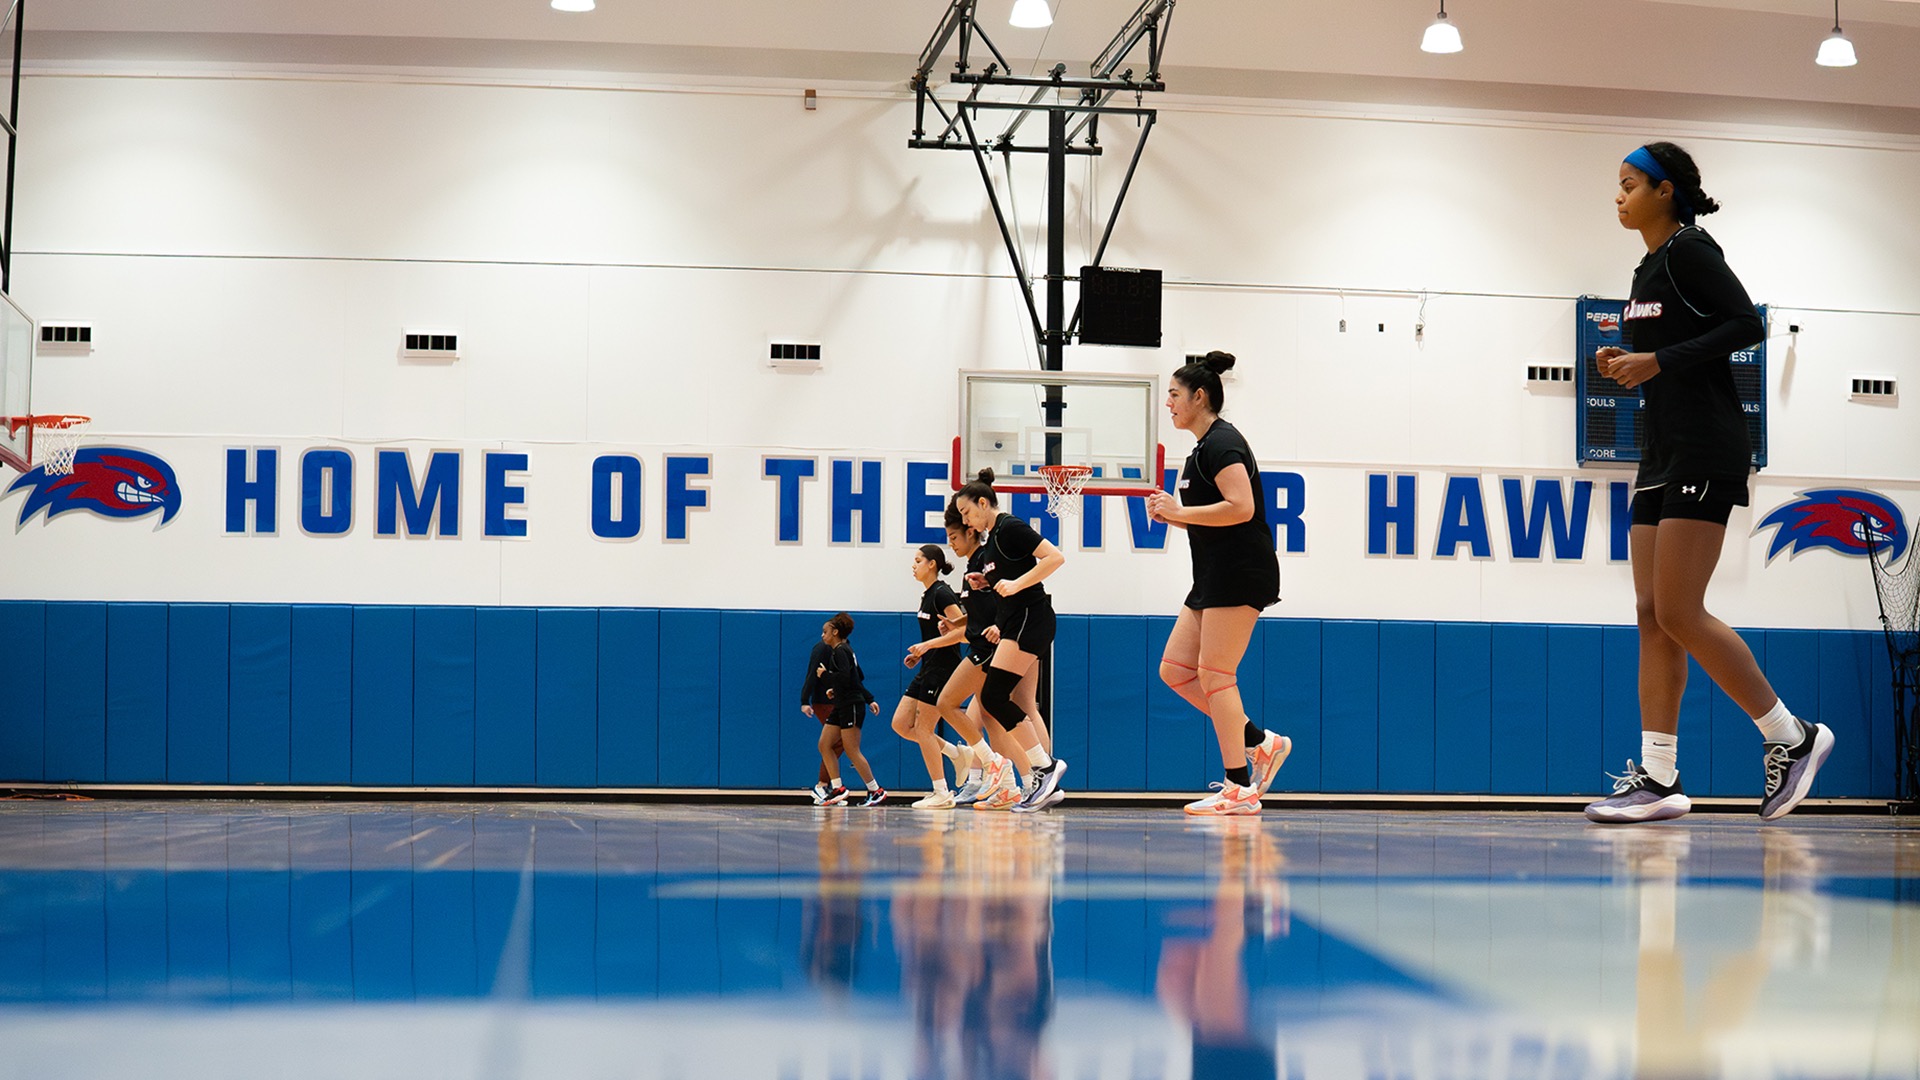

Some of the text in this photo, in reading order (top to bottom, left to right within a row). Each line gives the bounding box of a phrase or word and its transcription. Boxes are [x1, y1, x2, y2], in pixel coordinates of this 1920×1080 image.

[1586, 312, 1620, 323] PEPSI
[1731, 351, 1755, 363] EST
[225, 446, 530, 538] HOME
[589, 453, 712, 541] OF
[763, 457, 949, 545] THE
[1011, 462, 1308, 554] RIVR
